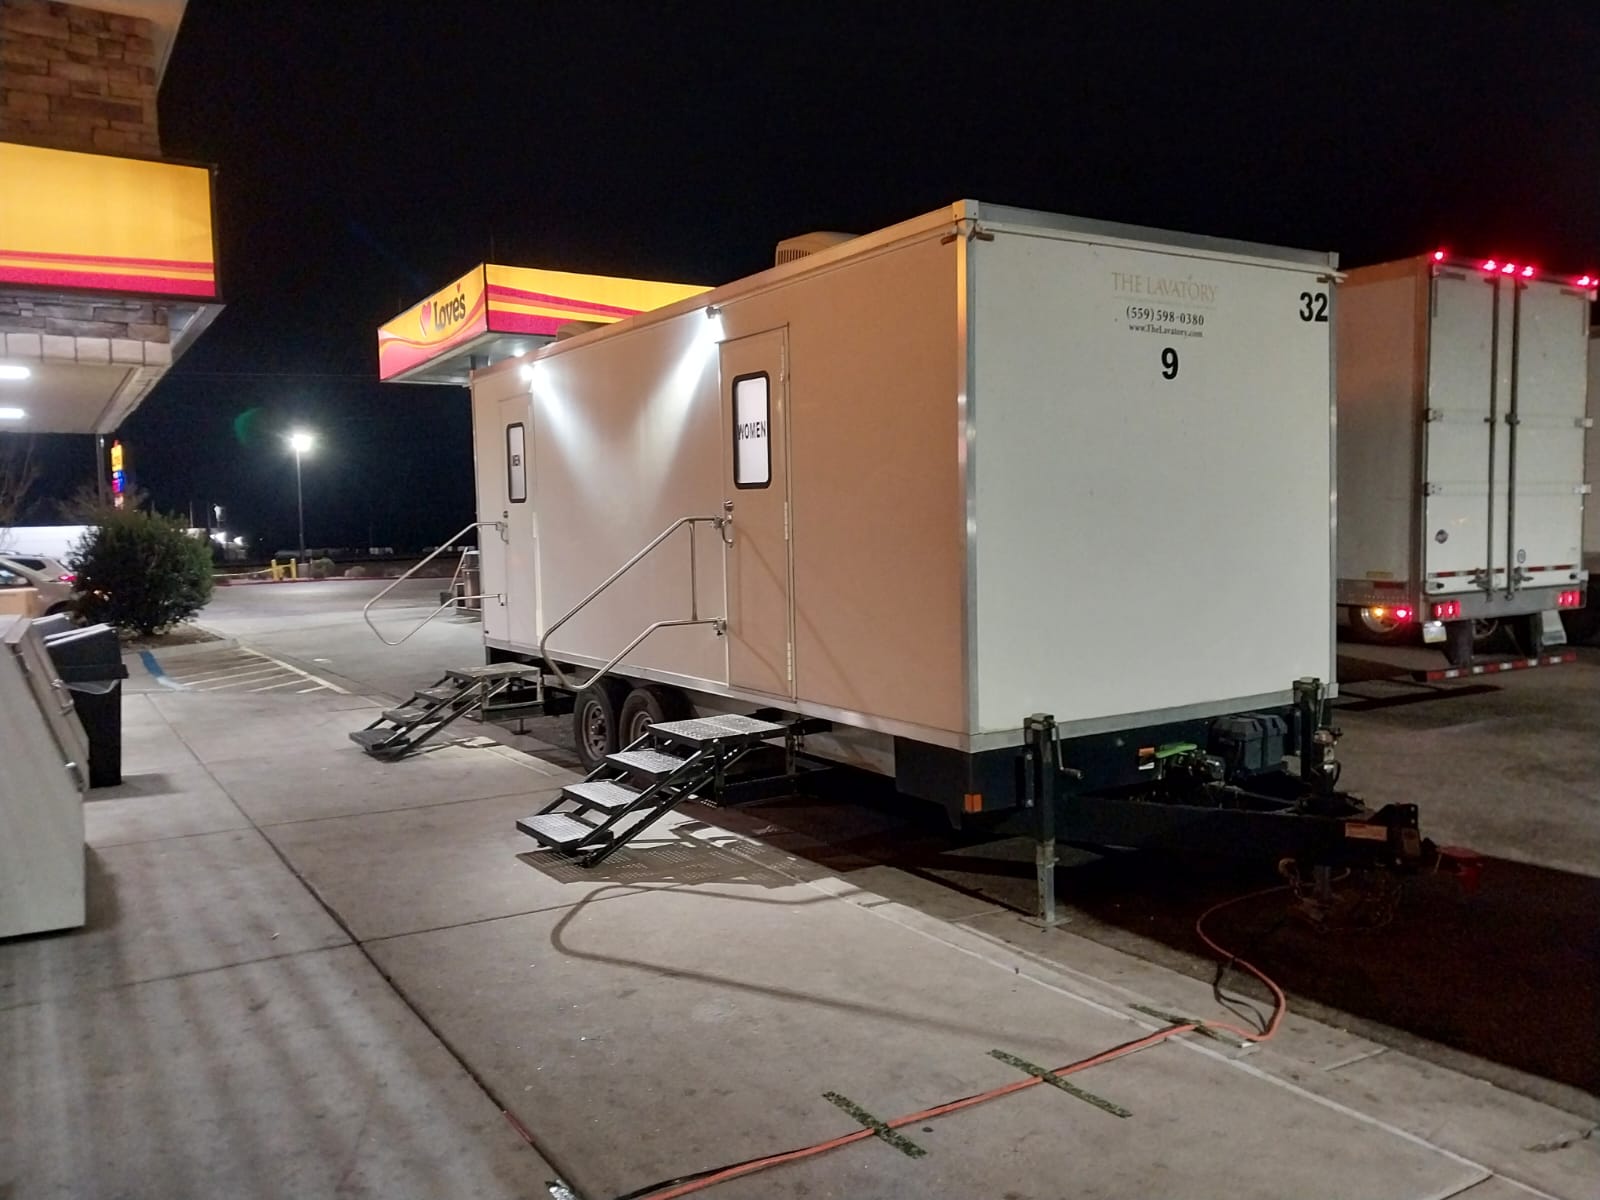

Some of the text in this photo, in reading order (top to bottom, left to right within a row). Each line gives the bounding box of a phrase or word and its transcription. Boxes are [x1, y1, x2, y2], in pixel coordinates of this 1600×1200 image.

[1111, 272, 1217, 302] THE LAVATORY
[433, 282, 466, 331] Love's
[1299, 291, 1328, 322] 32
[1161, 347, 1179, 380] 9
[737, 420, 767, 440] WOMEN
